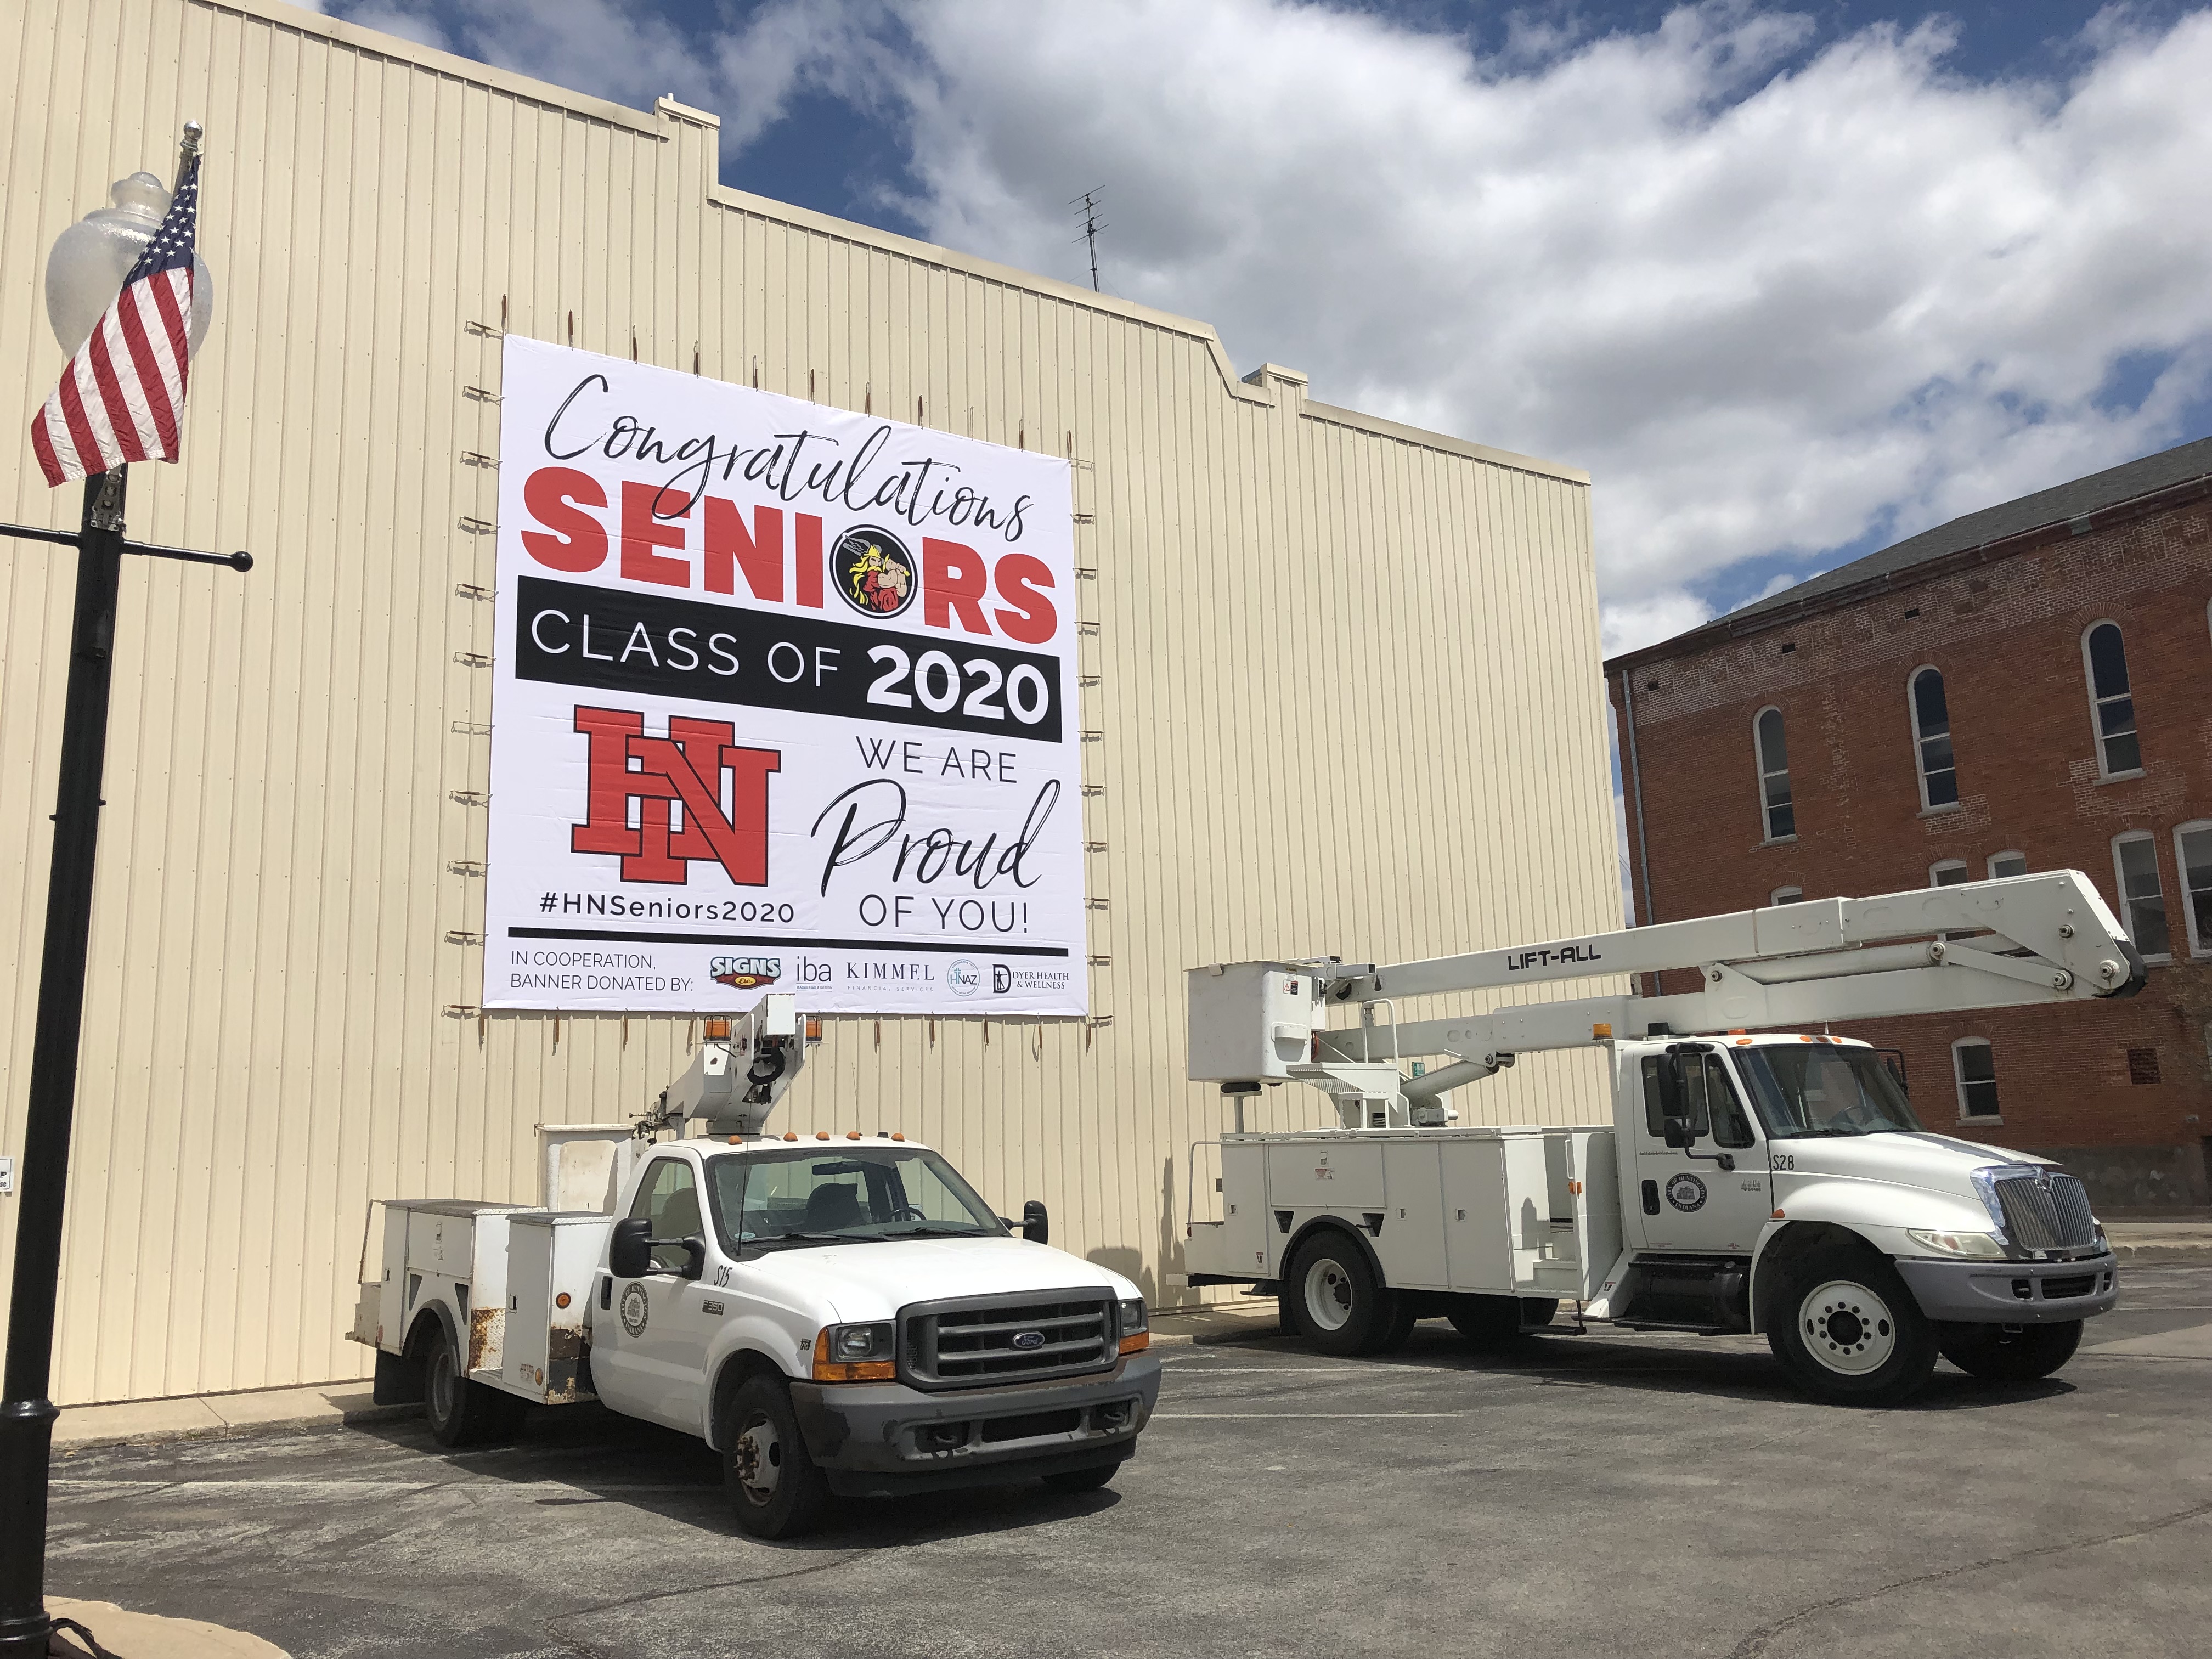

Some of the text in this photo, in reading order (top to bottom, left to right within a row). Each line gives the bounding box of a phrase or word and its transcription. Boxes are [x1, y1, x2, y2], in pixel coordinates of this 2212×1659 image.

[545, 374, 1034, 541] Congratulations
[531, 609, 1049, 725] CLASS OF 2020
[855, 736, 1018, 784] WE ARE
[810, 778, 1061, 898] Proud
[539, 891, 794, 924] #HNSeniors2020
[859, 894, 1029, 933] OF YOU!
[511, 950, 656, 970] IN COOPERATION,
[711, 957, 781, 978] SIGNS
[1508, 944, 1602, 970] LIFT-ALL
[797, 956, 831, 982] iba
[847, 962, 934, 980] KIMMEL
[1012, 971, 1069, 980] DYER HEALTH
[511, 973, 693, 992] BANNER DONATED BY:
[1024, 981, 1065, 989] WELLNESS
[1773, 1154, 1795, 1171] S28
[714, 1265, 733, 1288] S15
[703, 1301, 724, 1312] F350
[1022, 1335, 1039, 1345] Ford
